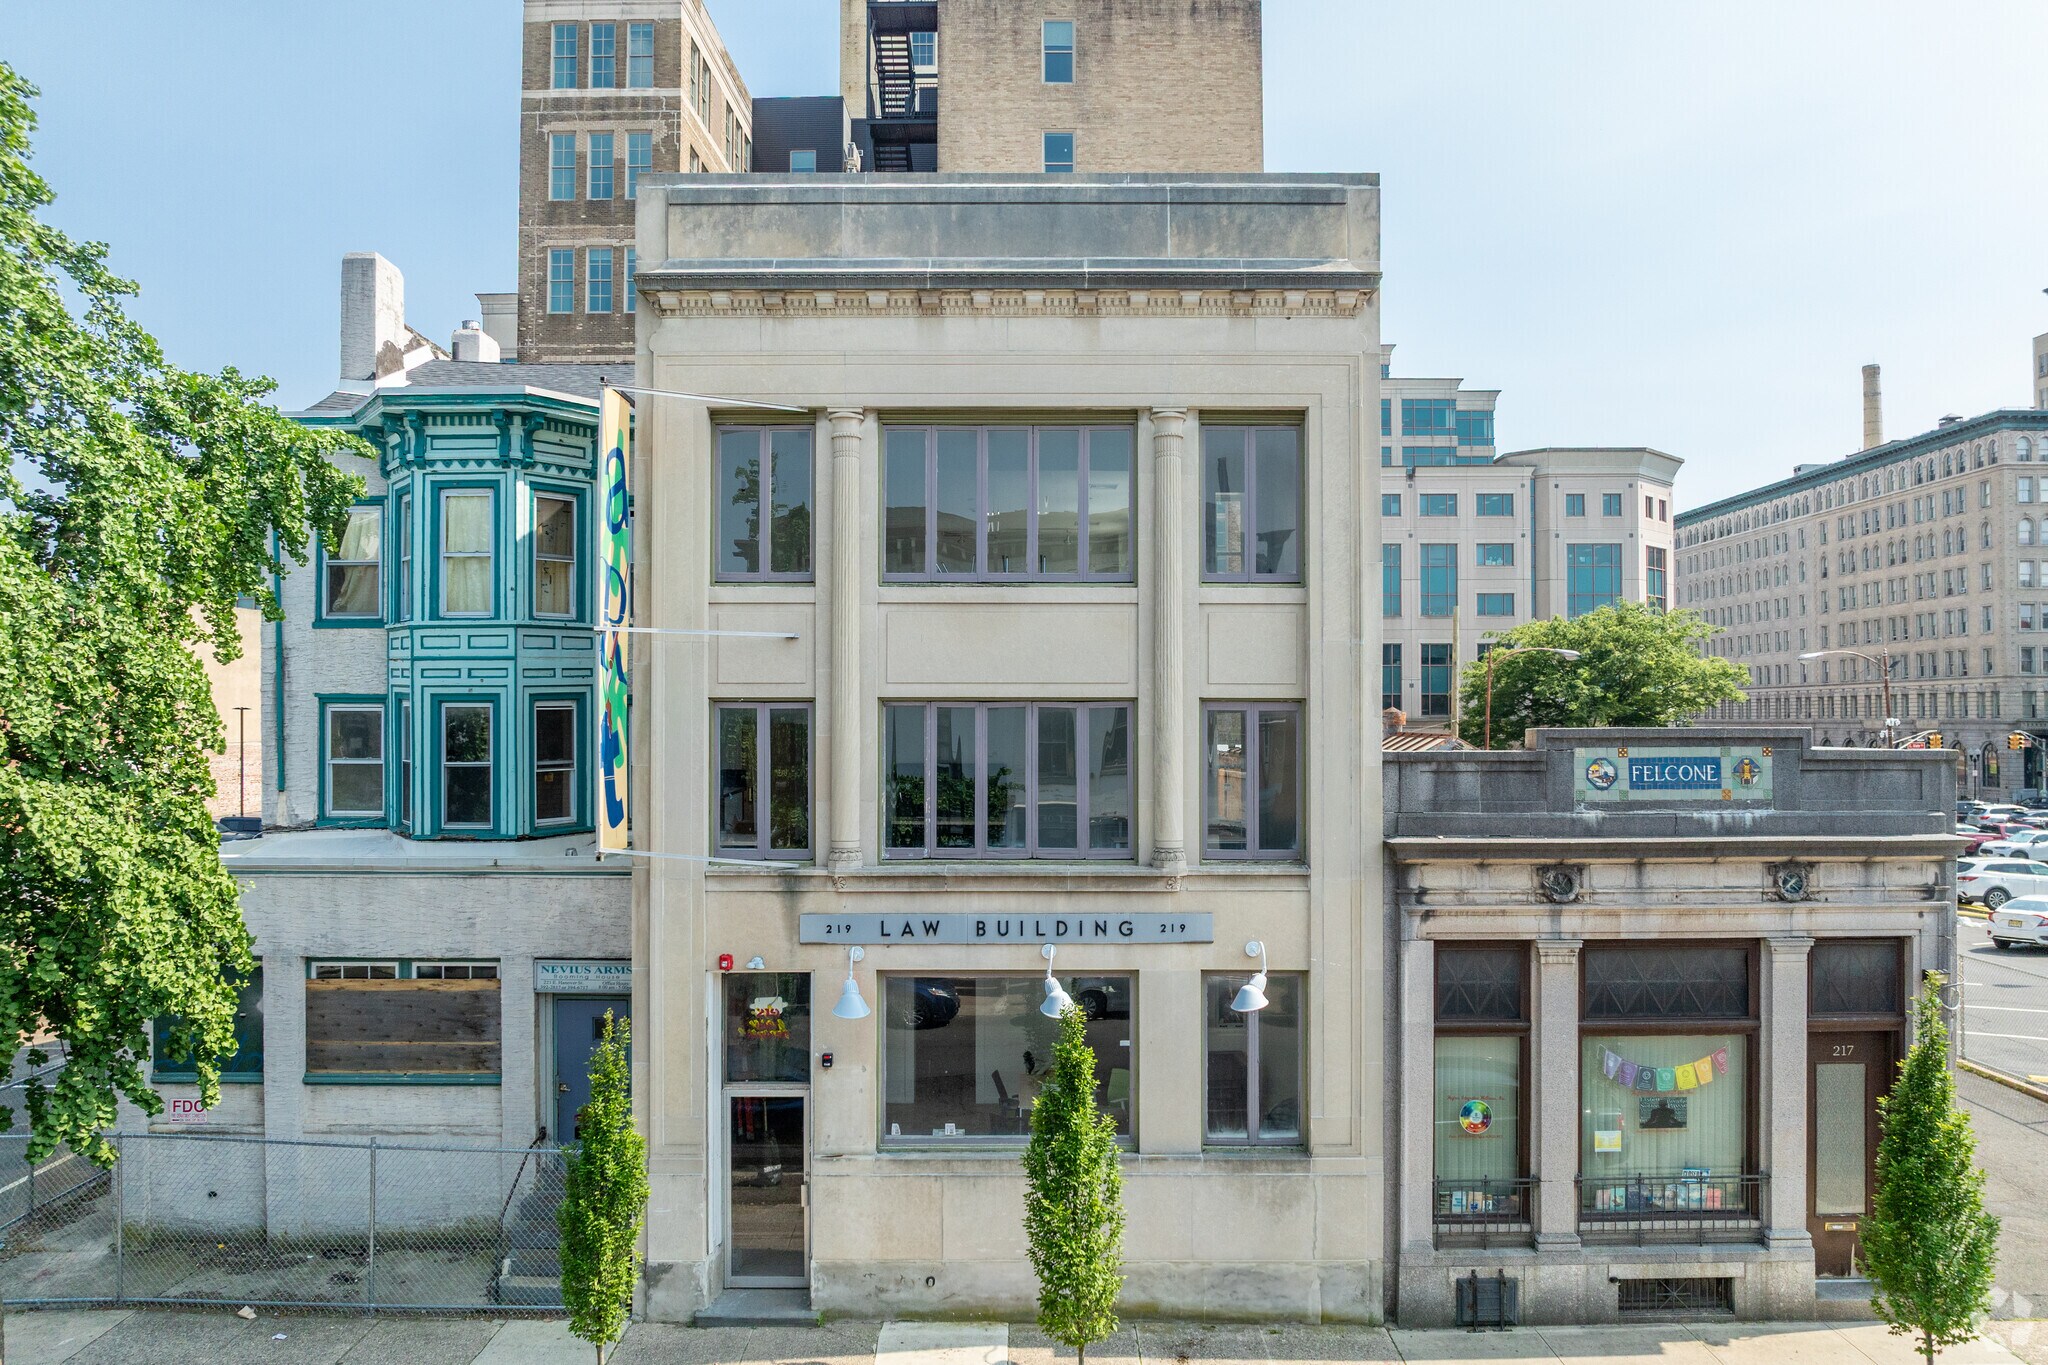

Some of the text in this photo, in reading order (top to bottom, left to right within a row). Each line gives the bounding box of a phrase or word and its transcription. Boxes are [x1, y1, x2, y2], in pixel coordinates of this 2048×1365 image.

[1632, 764, 1718, 782] FELCONE
[826, 920, 1186, 937] 219 LAW BUILDING 219
[541, 966, 632, 974] NEVIUS ARMS
[1832, 1045, 1854, 1056] 217
[173, 1100, 205, 1113] FDC
